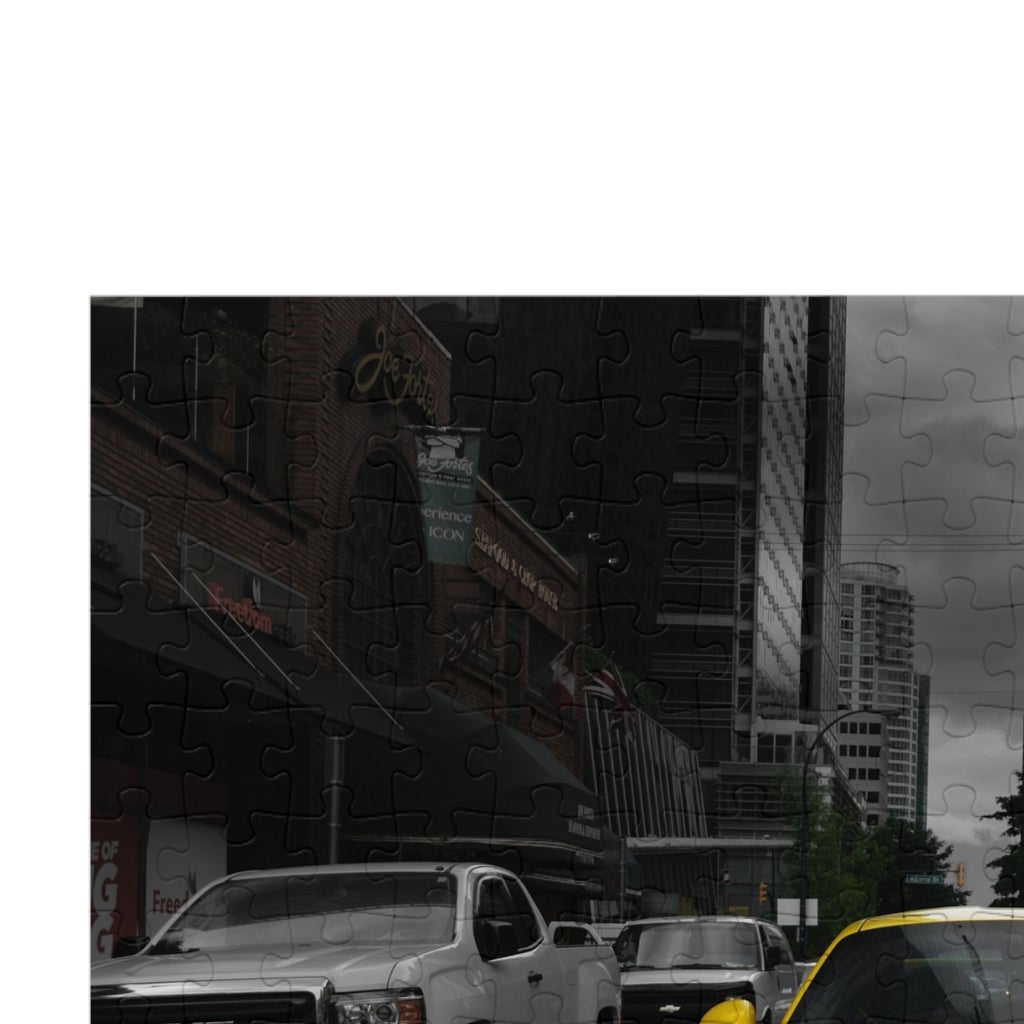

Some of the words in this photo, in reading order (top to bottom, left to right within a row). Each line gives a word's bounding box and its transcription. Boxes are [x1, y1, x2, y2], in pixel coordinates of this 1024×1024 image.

[354, 324, 401, 393] Joe
[421, 507, 472, 524] erience
[428, 525, 464, 542] ICON
[101, 840, 119, 861] OF
[91, 861, 119, 912] G
